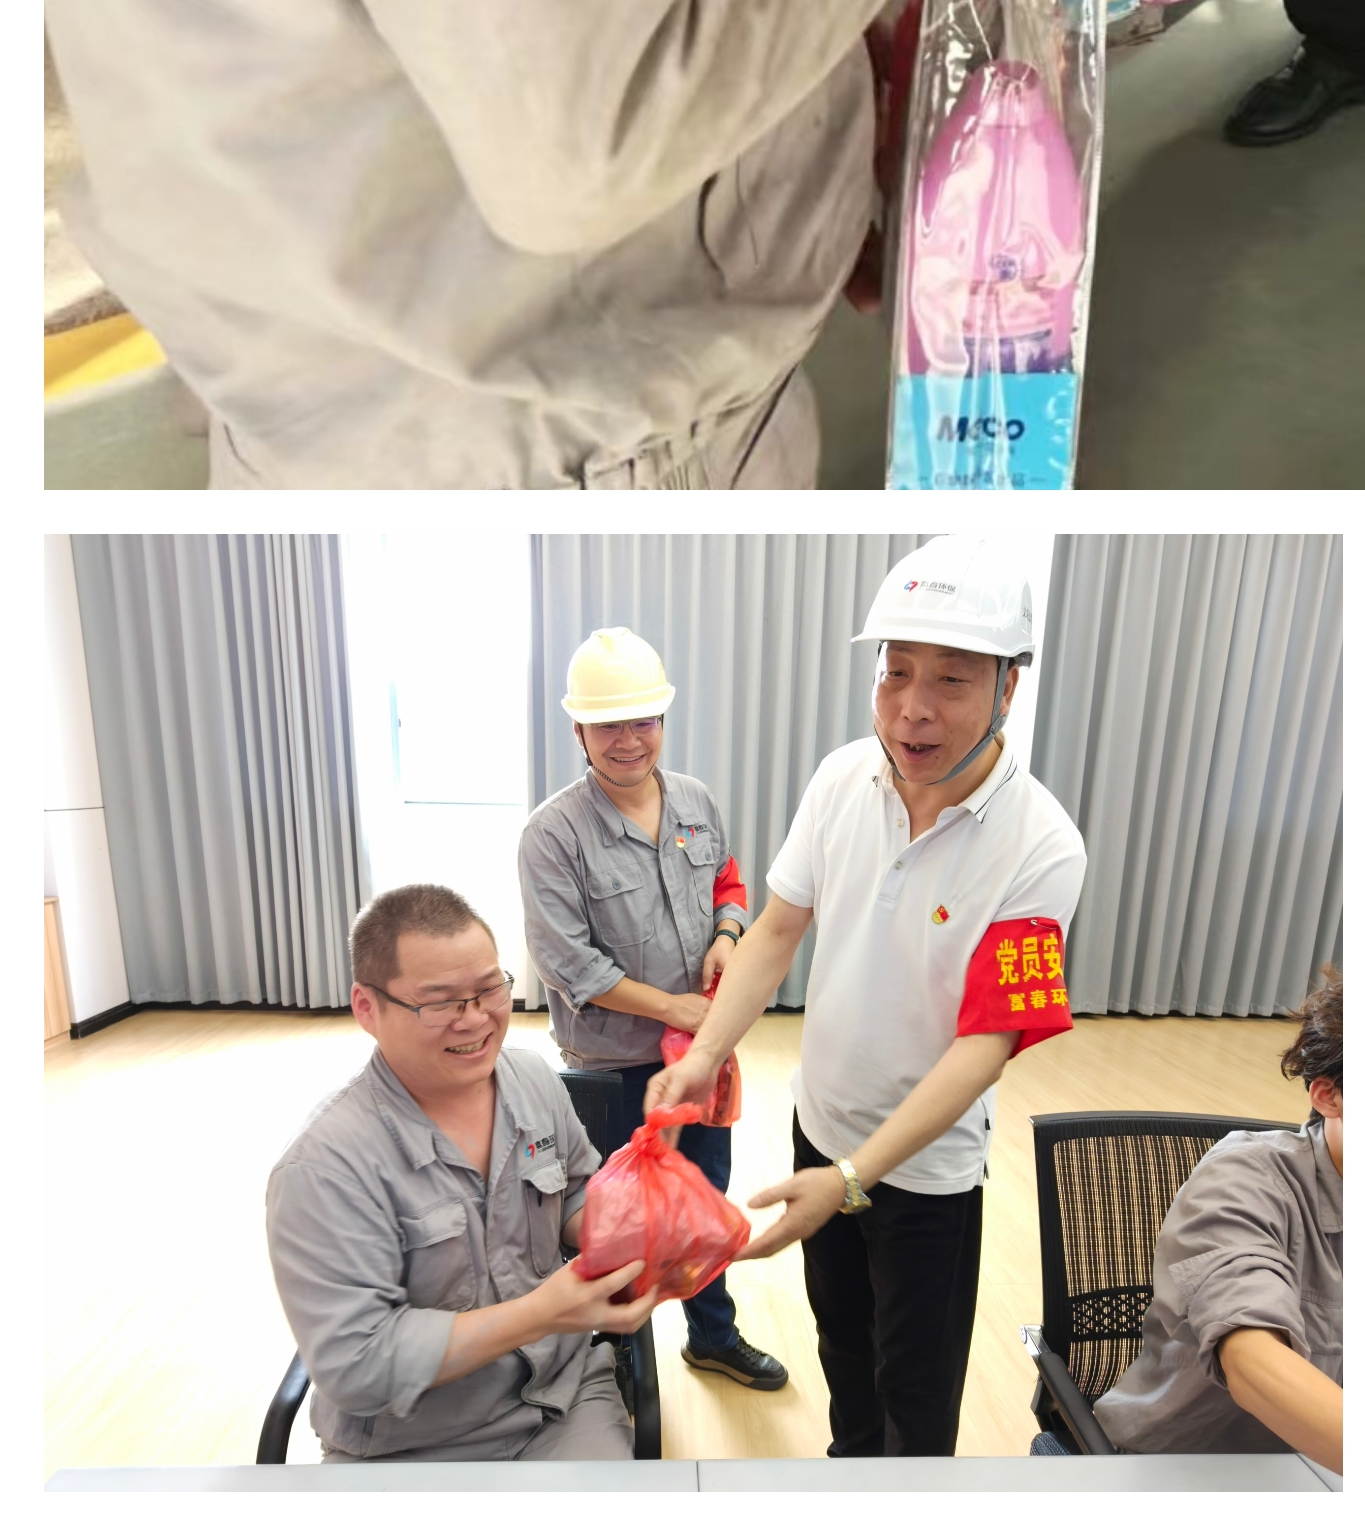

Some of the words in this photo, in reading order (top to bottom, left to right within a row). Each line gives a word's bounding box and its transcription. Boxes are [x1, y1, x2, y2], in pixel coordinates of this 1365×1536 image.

[996, 933, 1064, 985] 党员安
[1008, 989, 1068, 1011] 富春环
